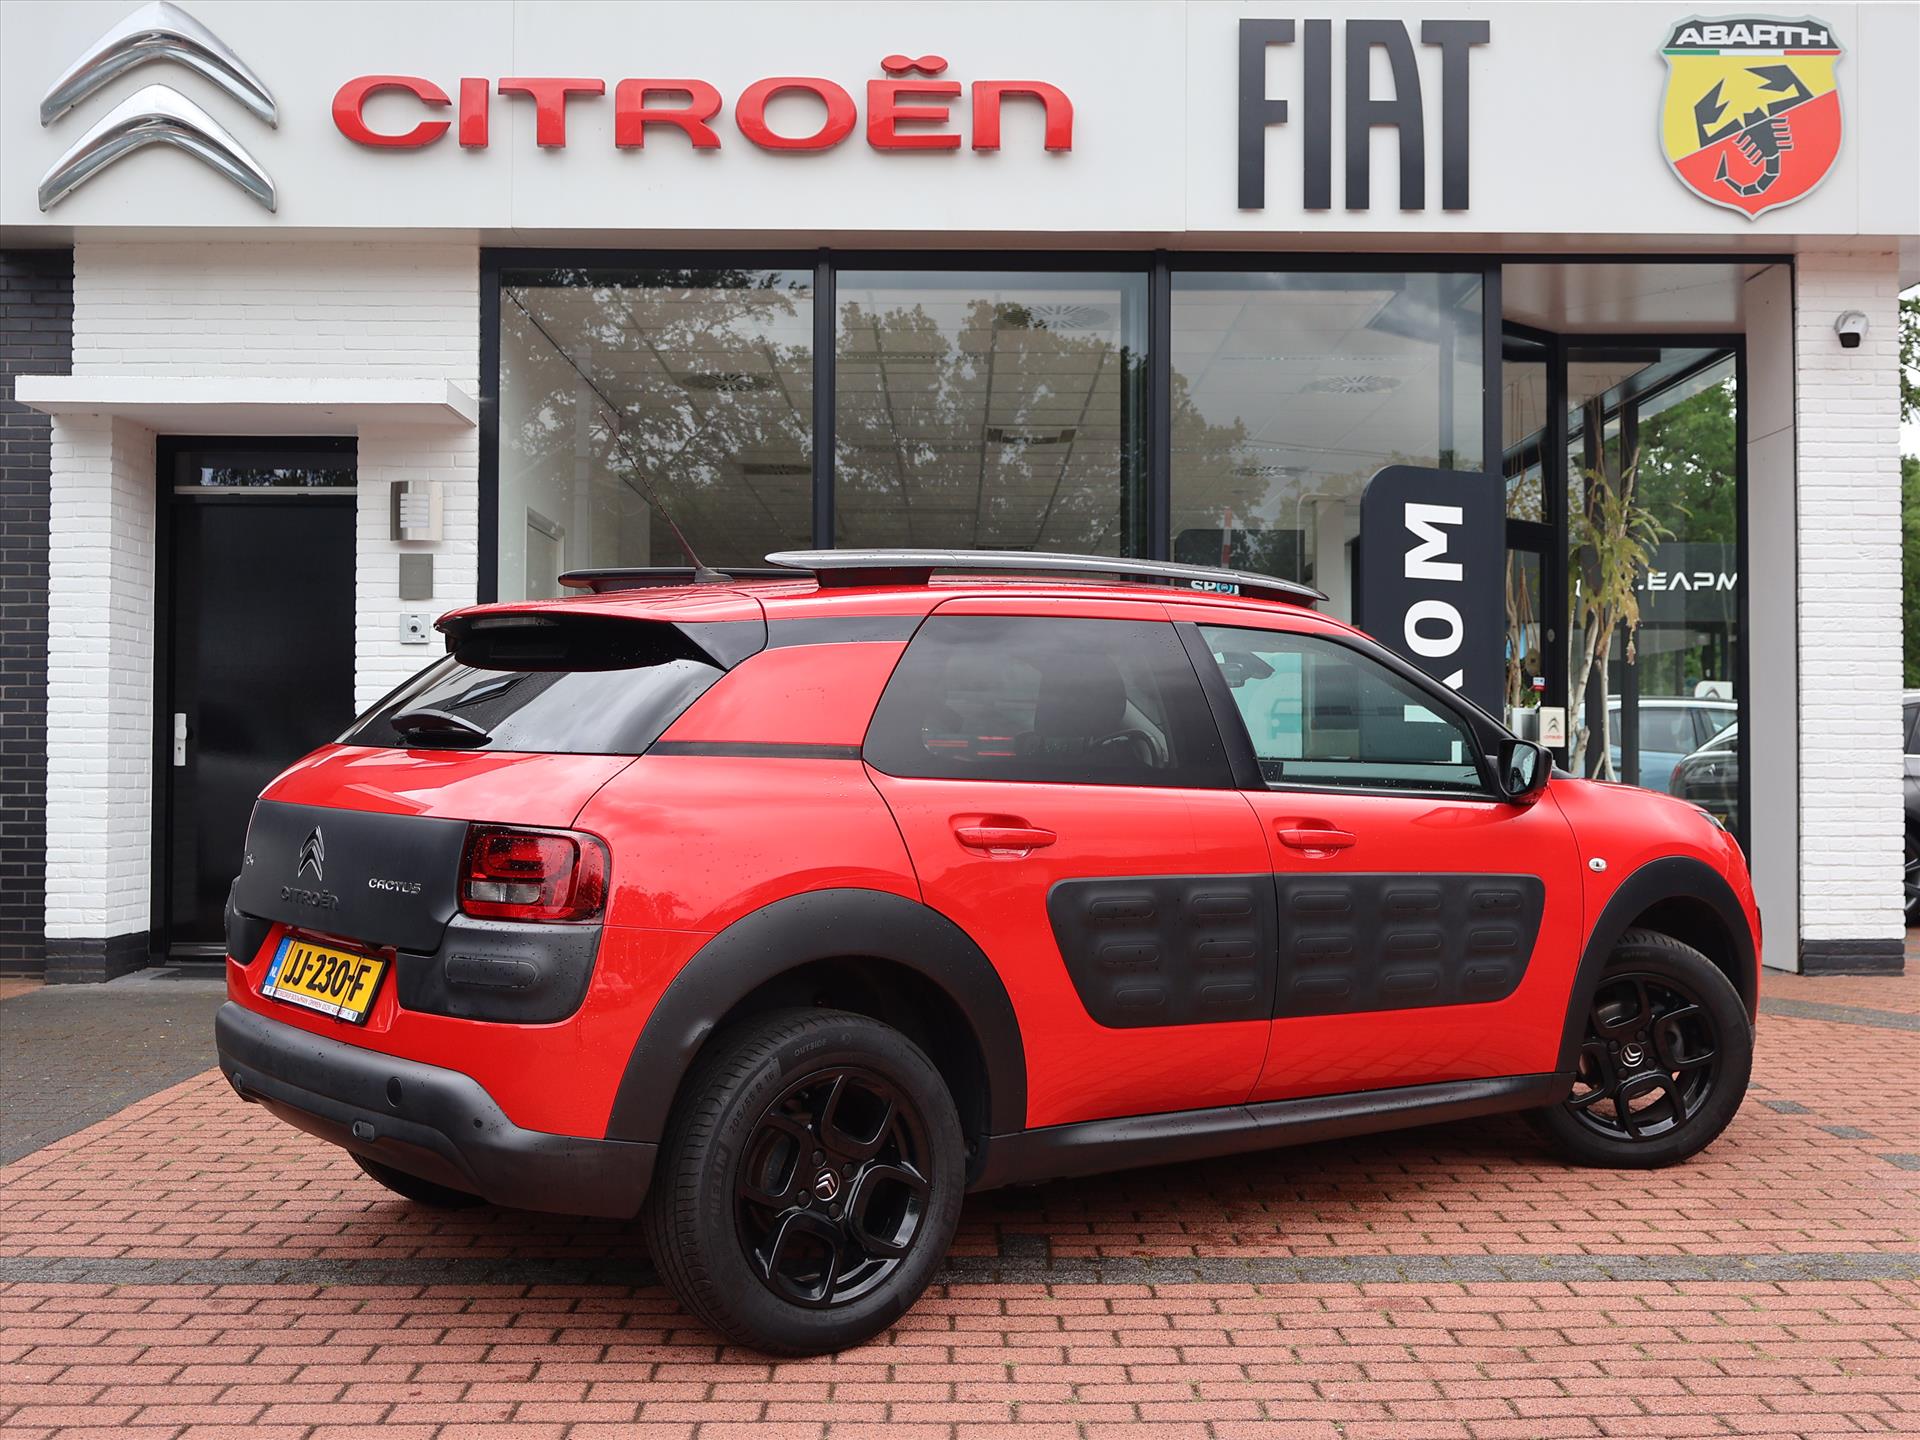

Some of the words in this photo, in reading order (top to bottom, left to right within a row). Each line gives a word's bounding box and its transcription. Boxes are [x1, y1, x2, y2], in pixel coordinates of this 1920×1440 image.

[1675, 24, 1828, 45] ABARTH
[332, 54, 1073, 152] CITROËN
[1237, 19, 1490, 210] FIAT
[368, 878, 422, 894] CACTUS
[269, 966, 277, 978] NL
[283, 949, 371, 1002] JJ-230-F
[794, 1038, 828, 1057] OUTSIDE
